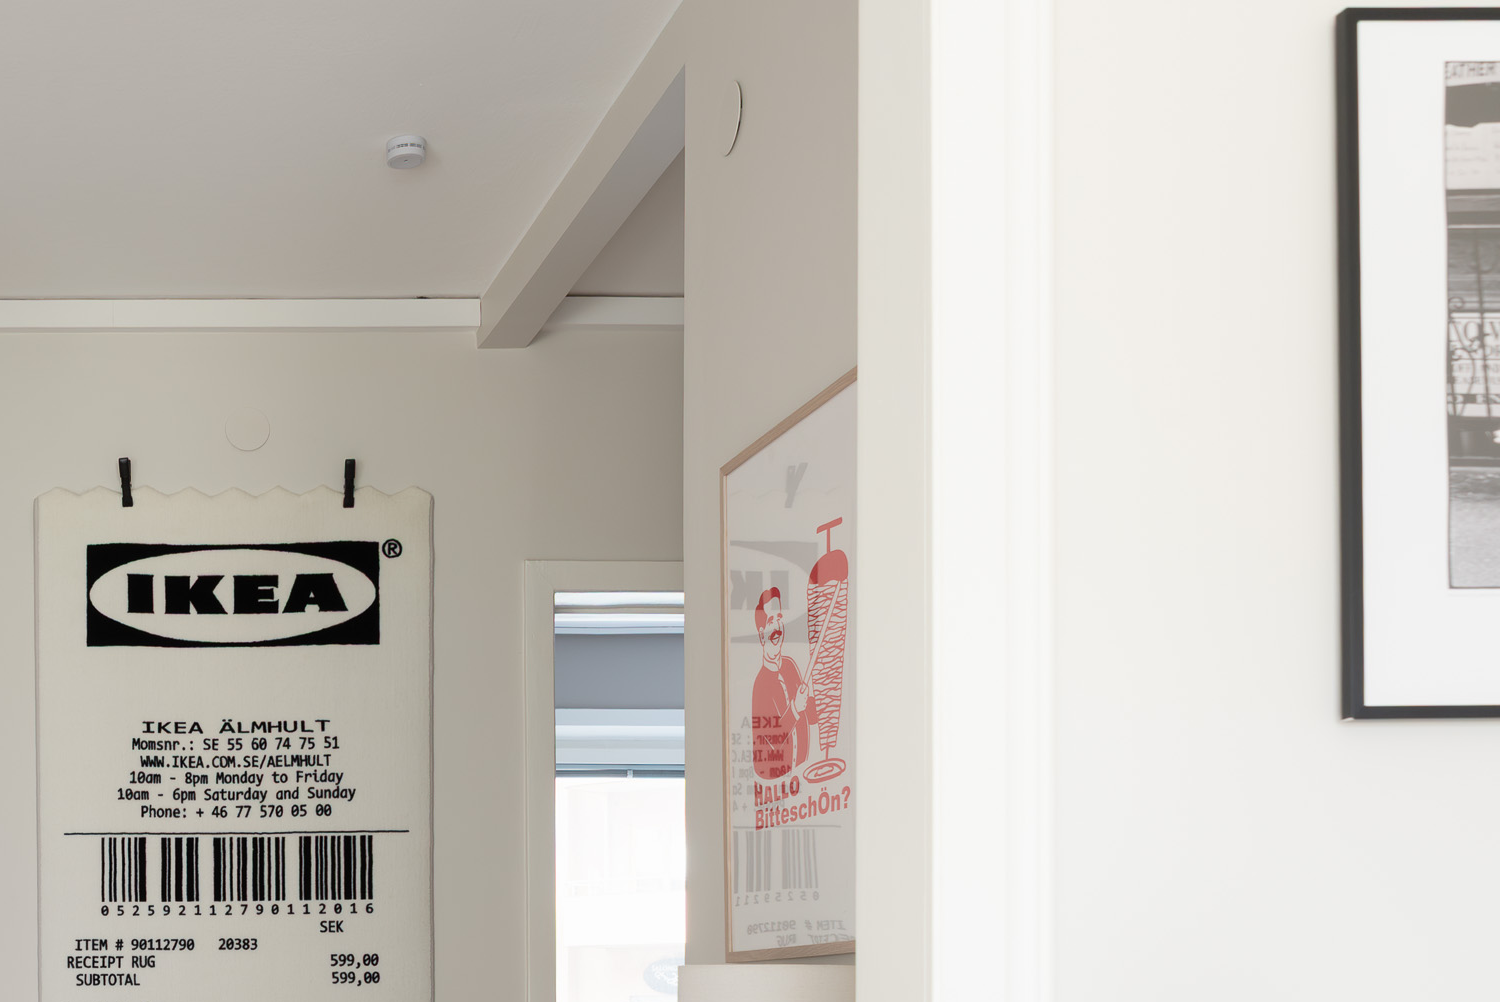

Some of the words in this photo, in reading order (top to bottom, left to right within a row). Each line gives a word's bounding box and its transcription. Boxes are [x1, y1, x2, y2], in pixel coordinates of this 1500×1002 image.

[126, 572, 349, 615] IKEA
[142, 720, 204, 735] IKEA
[218, 718, 331, 735] ÄLMHULT
[131, 737, 194, 751] Momsnr.:
[202, 737, 220, 751] SE
[227, 737, 243, 751] 55
[250, 737, 268, 751] 60
[274, 736, 292, 751] 74
[298, 736, 316, 750] 75
[323, 735, 340, 750] 51
[139, 753, 332, 768] WWW.IKEA.COM.SE/AELMHULT
[129, 770, 162, 785] 10am
[184, 771, 209, 788] 8pm
[215, 771, 264, 787] Monday
[271, 771, 289, 784] to
[295, 770, 344, 787] Friday
[117, 787, 150, 801] 10am
[172, 787, 197, 804] 6pm
[203, 787, 268, 803] Saturday
[275, 786, 300, 801] and
[304, 786, 357, 802] Sunday
[754, 775, 800, 807] HALLO
[140, 804, 187, 819] Phone:
[211, 805, 228, 819] 46
[235, 804, 252, 818] 77
[259, 804, 284, 819] 570
[290, 803, 308, 818] 05
[315, 803, 332, 817] 00
[755, 785, 851, 831] BitteschÖn?
[319, 919, 344, 934] SEK
[74, 938, 109, 952] ITEM
[130, 938, 195, 951] 90112790
[218, 937, 258, 951] 20383
[67, 955, 125, 969] RECEIPT
[131, 954, 156, 969] RUG
[330, 953, 380, 969] 599,00
[75, 973, 141, 987] SUBTOTAL
[331, 971, 381, 987] 599,00
